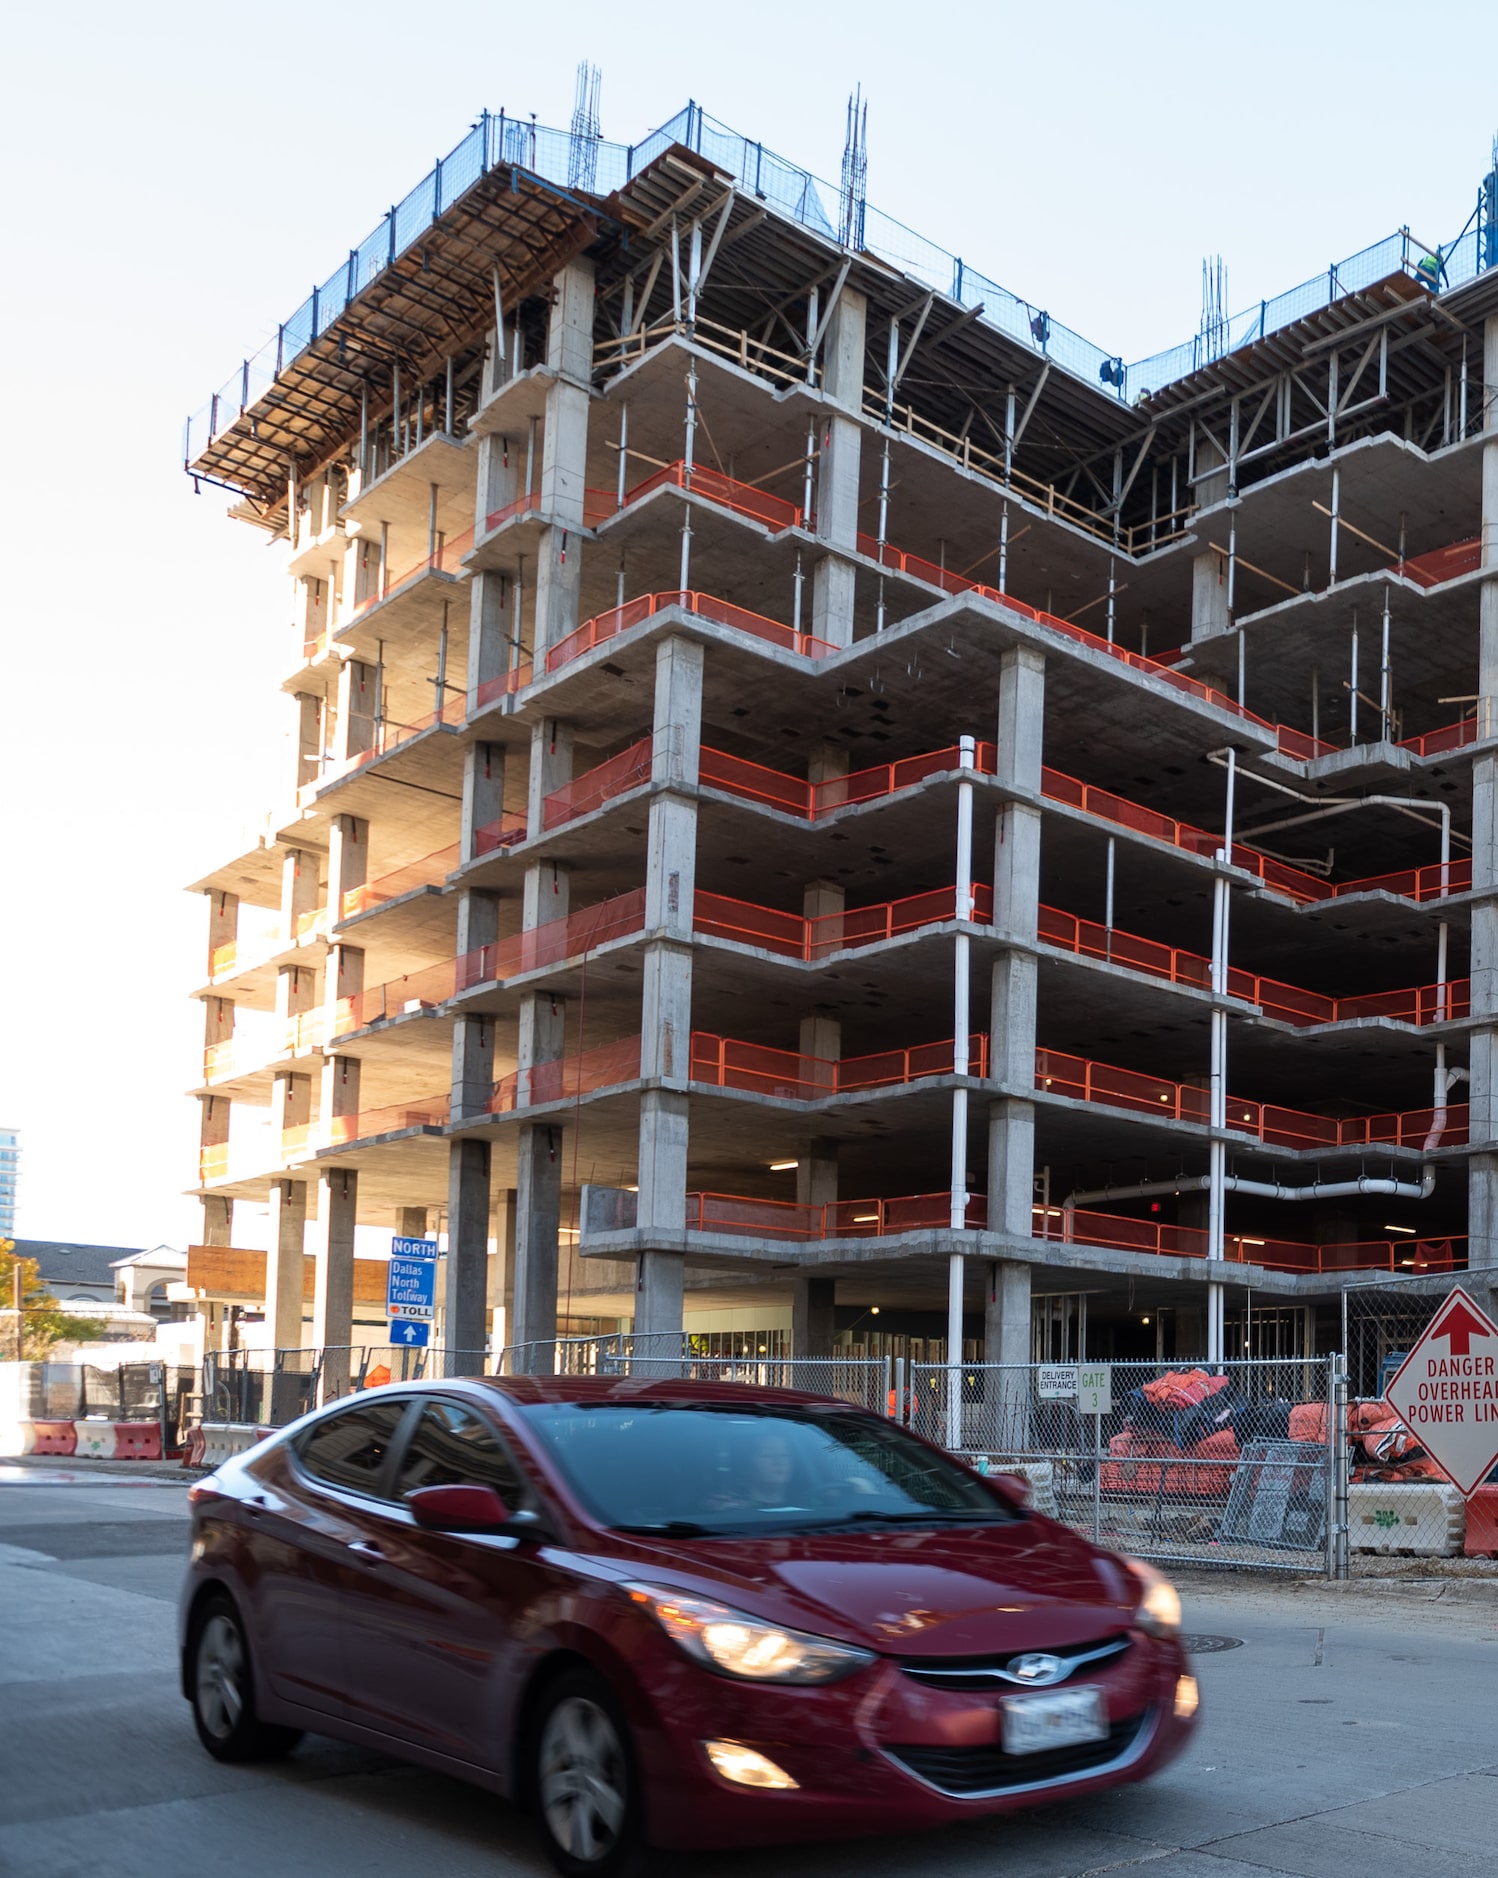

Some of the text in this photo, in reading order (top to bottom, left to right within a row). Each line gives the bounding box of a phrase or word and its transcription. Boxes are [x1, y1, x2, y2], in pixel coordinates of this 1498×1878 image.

[393, 1239, 436, 1257] NORTH
[392, 1261, 423, 1276] Dallas
[391, 1275, 420, 1289] North
[391, 1288, 428, 1305] Tollway
[401, 1305, 432, 1317] TOLL
[1427, 1356, 1495, 1378] DANGER
[1041, 1371, 1075, 1380] DELIVERY
[1082, 1372, 1105, 1388] GATE
[1040, 1380, 1077, 1390] ENTRANCE
[1092, 1393, 1098, 1408] 3
[1408, 1404, 1465, 1423] POWER
